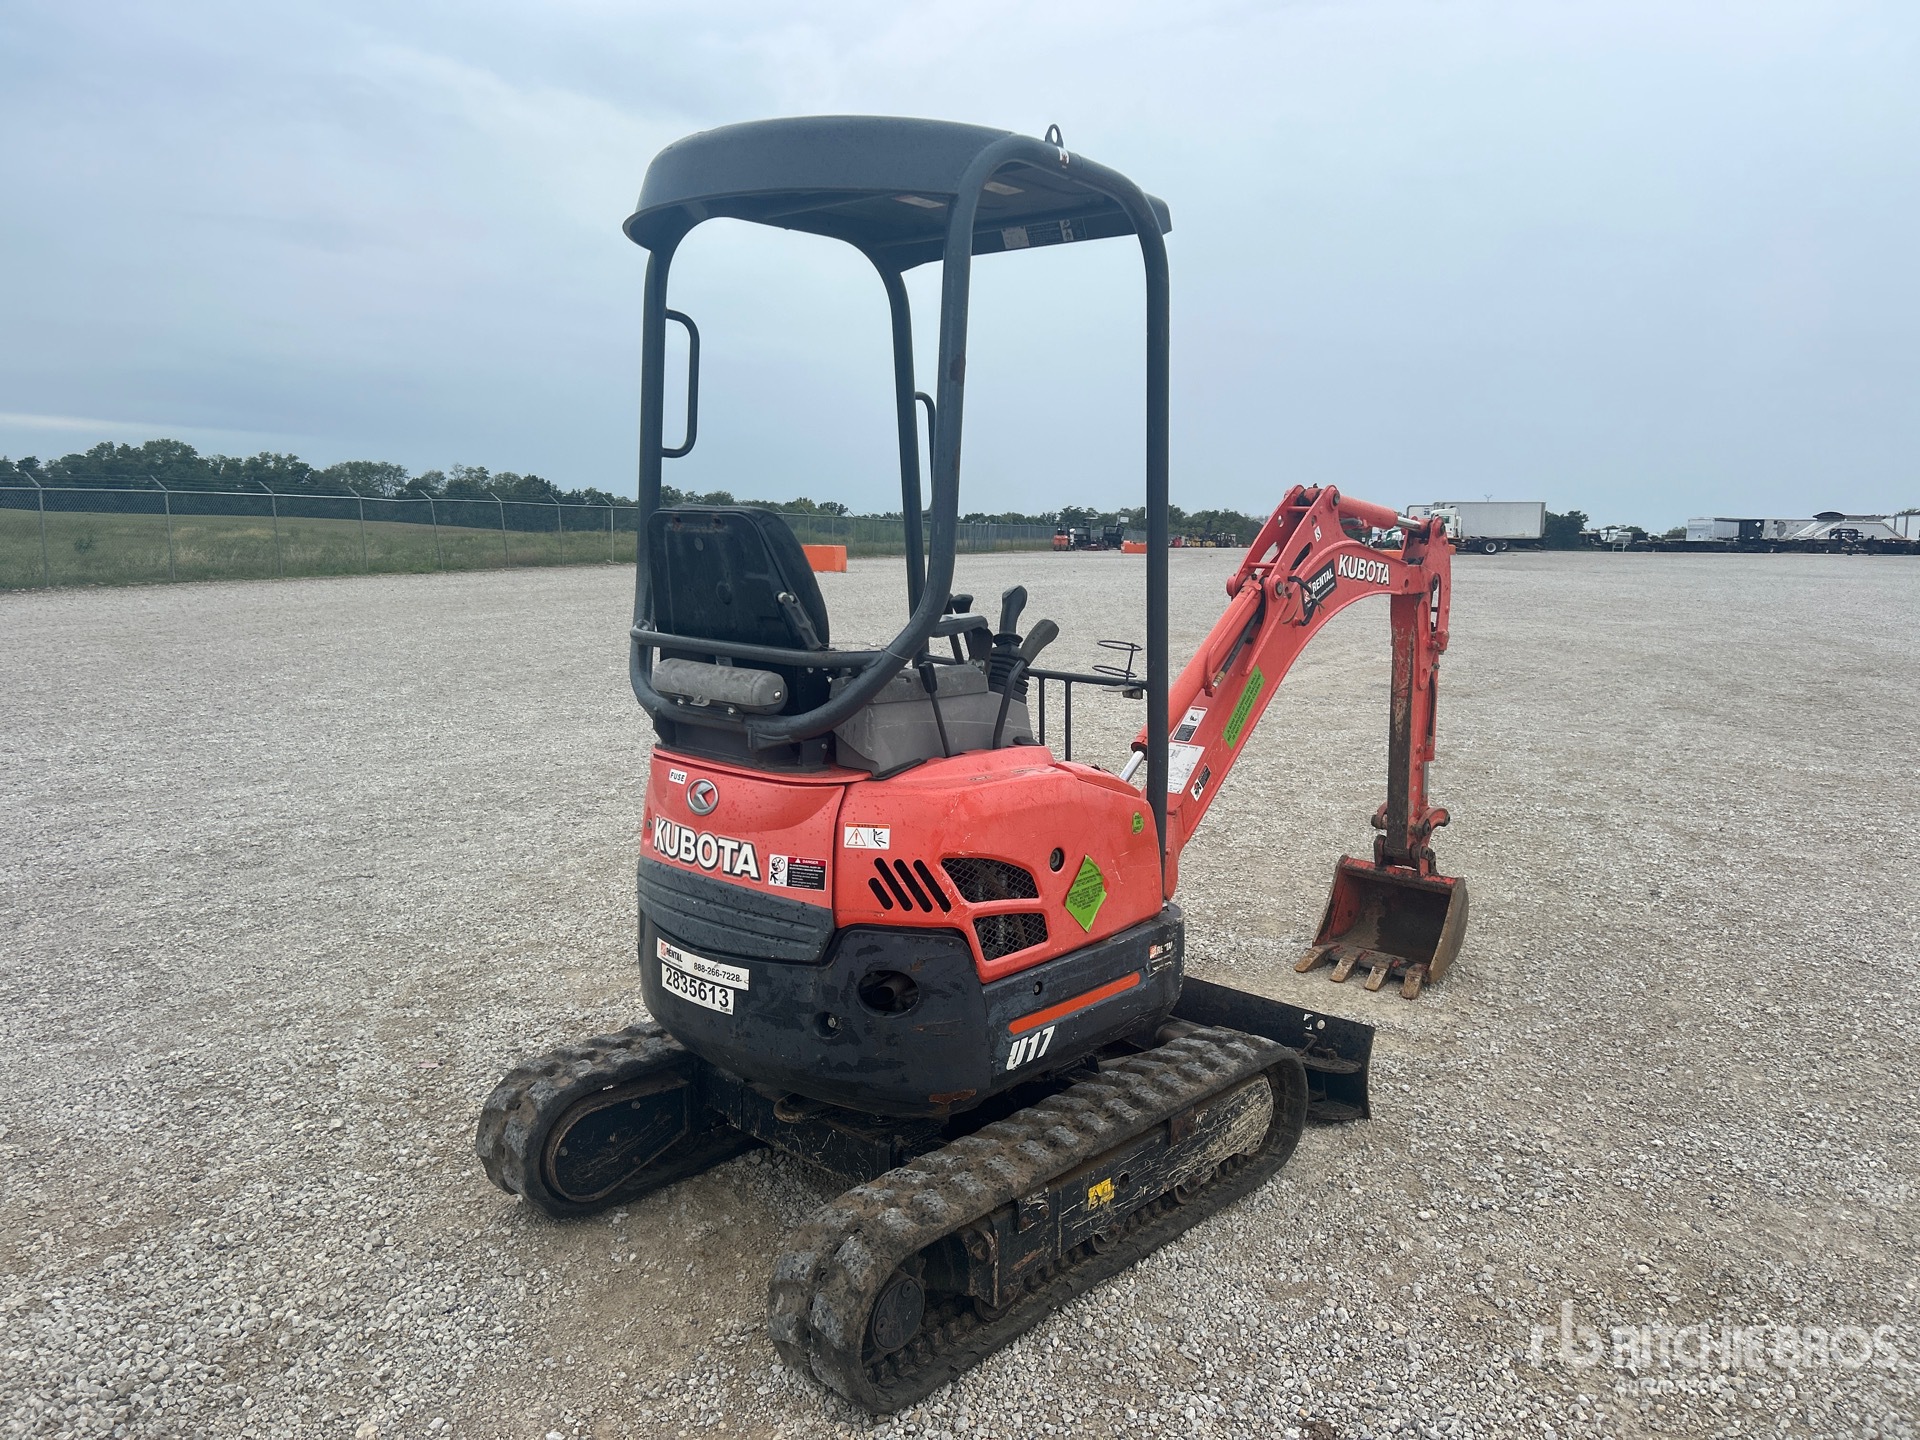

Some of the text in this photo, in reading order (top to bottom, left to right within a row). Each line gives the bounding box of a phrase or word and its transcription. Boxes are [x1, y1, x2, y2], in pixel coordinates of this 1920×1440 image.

[1312, 567, 1334, 593] RENTAL
[1338, 554, 1390, 586] KUBOTA
[670, 771, 686, 782] FUSE
[654, 816, 760, 881] KUBOTA
[665, 967, 729, 1008] 2835613
[1006, 1025, 1055, 1071] U17
